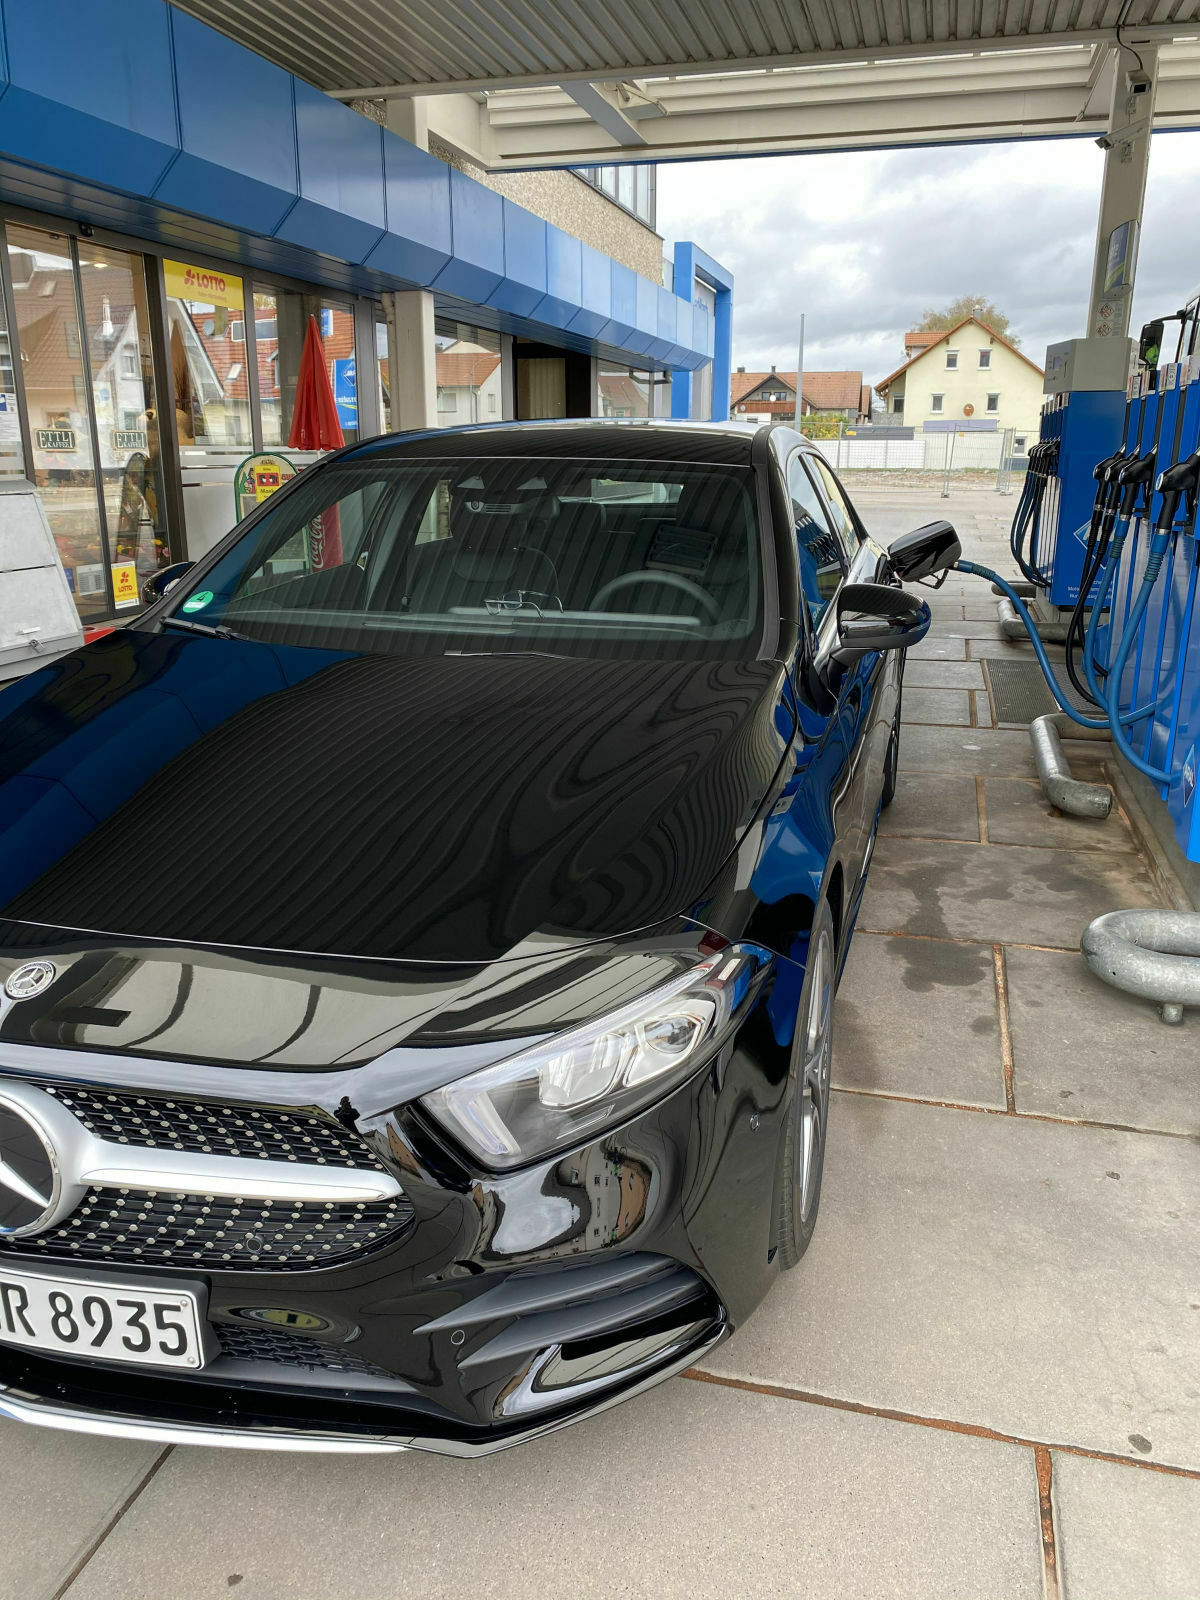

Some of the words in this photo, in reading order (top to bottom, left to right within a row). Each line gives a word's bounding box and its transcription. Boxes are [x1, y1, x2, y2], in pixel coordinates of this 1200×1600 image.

[196, 272, 226, 292] LOTTO
[39, 430, 74, 449] ETTLI
[116, 432, 145, 449] ETTLI
[118, 584, 133, 593] LOTTO
[0, 1281, 36, 1337] R
[48, 1291, 188, 1356] 8935
